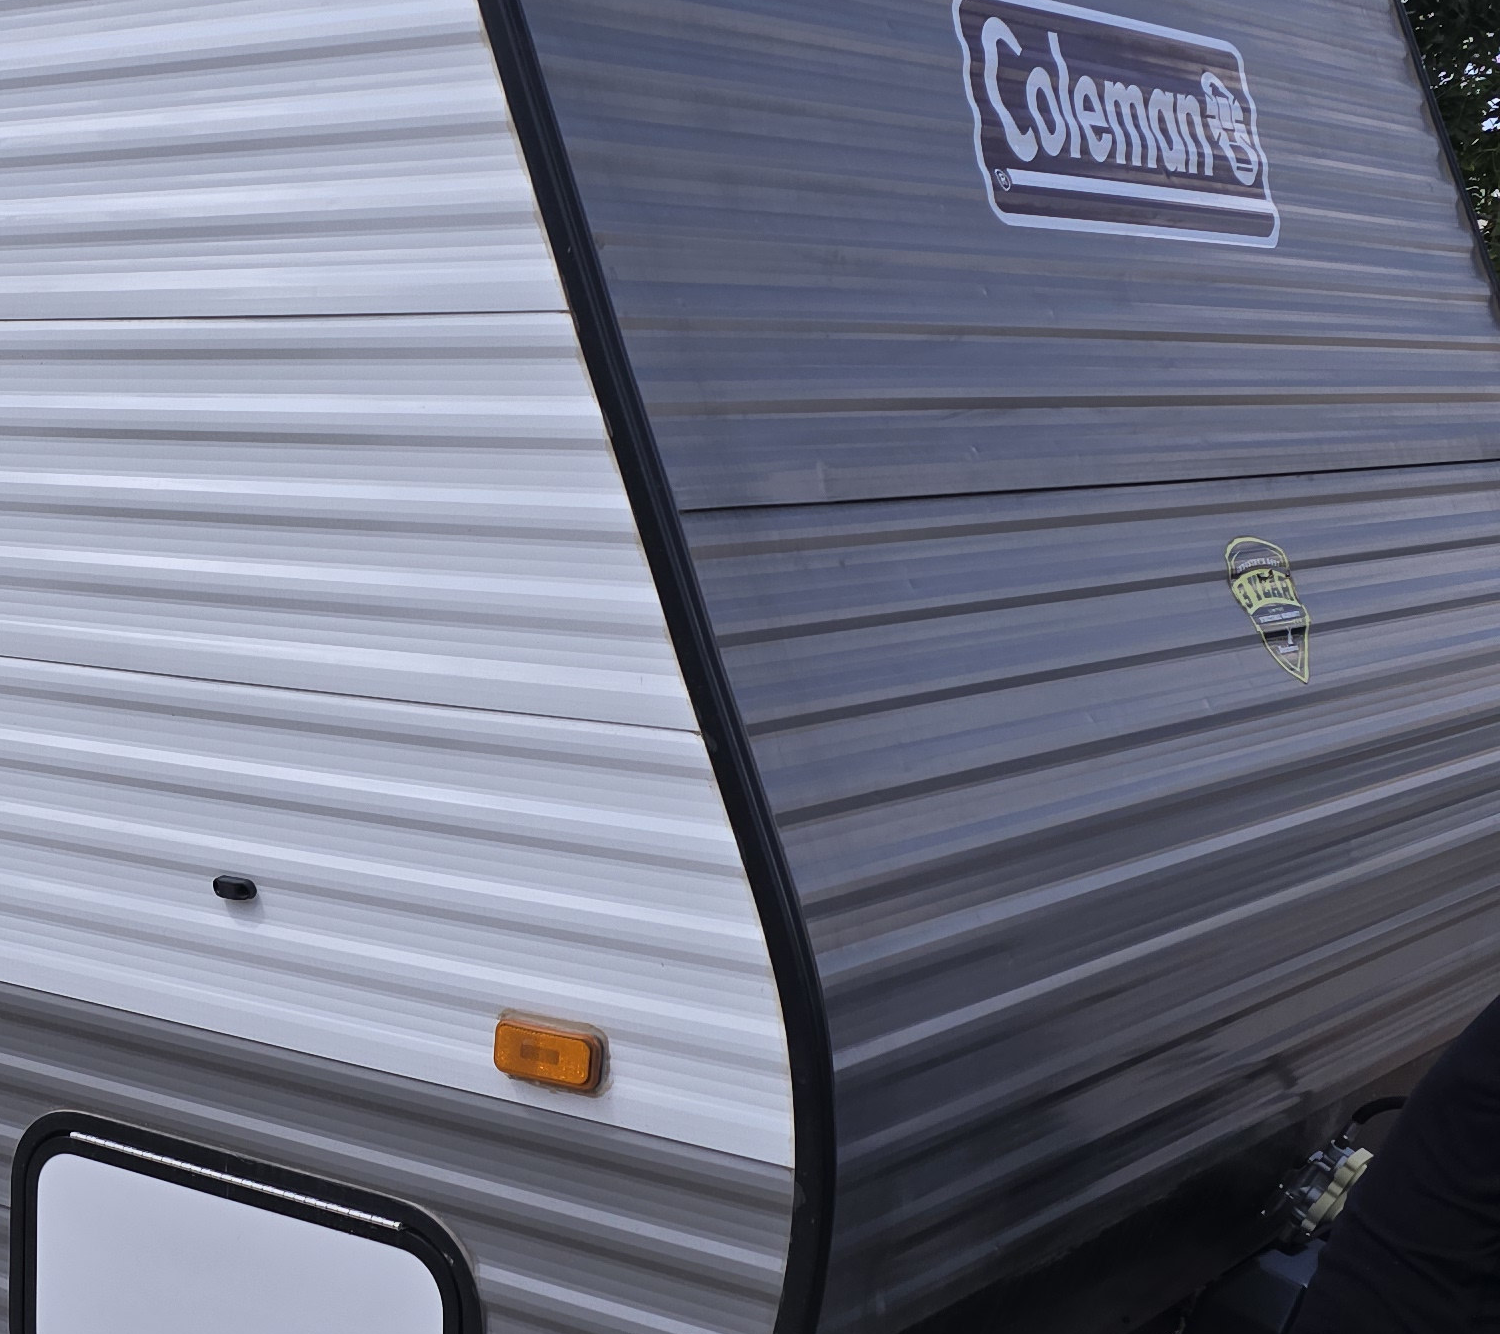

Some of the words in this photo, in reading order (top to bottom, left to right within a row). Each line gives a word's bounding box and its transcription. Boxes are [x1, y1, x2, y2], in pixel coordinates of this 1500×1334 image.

[981, 16, 1214, 176] Coleman
[1237, 582, 1254, 609] 3
[1247, 571, 1295, 602] YEAR
